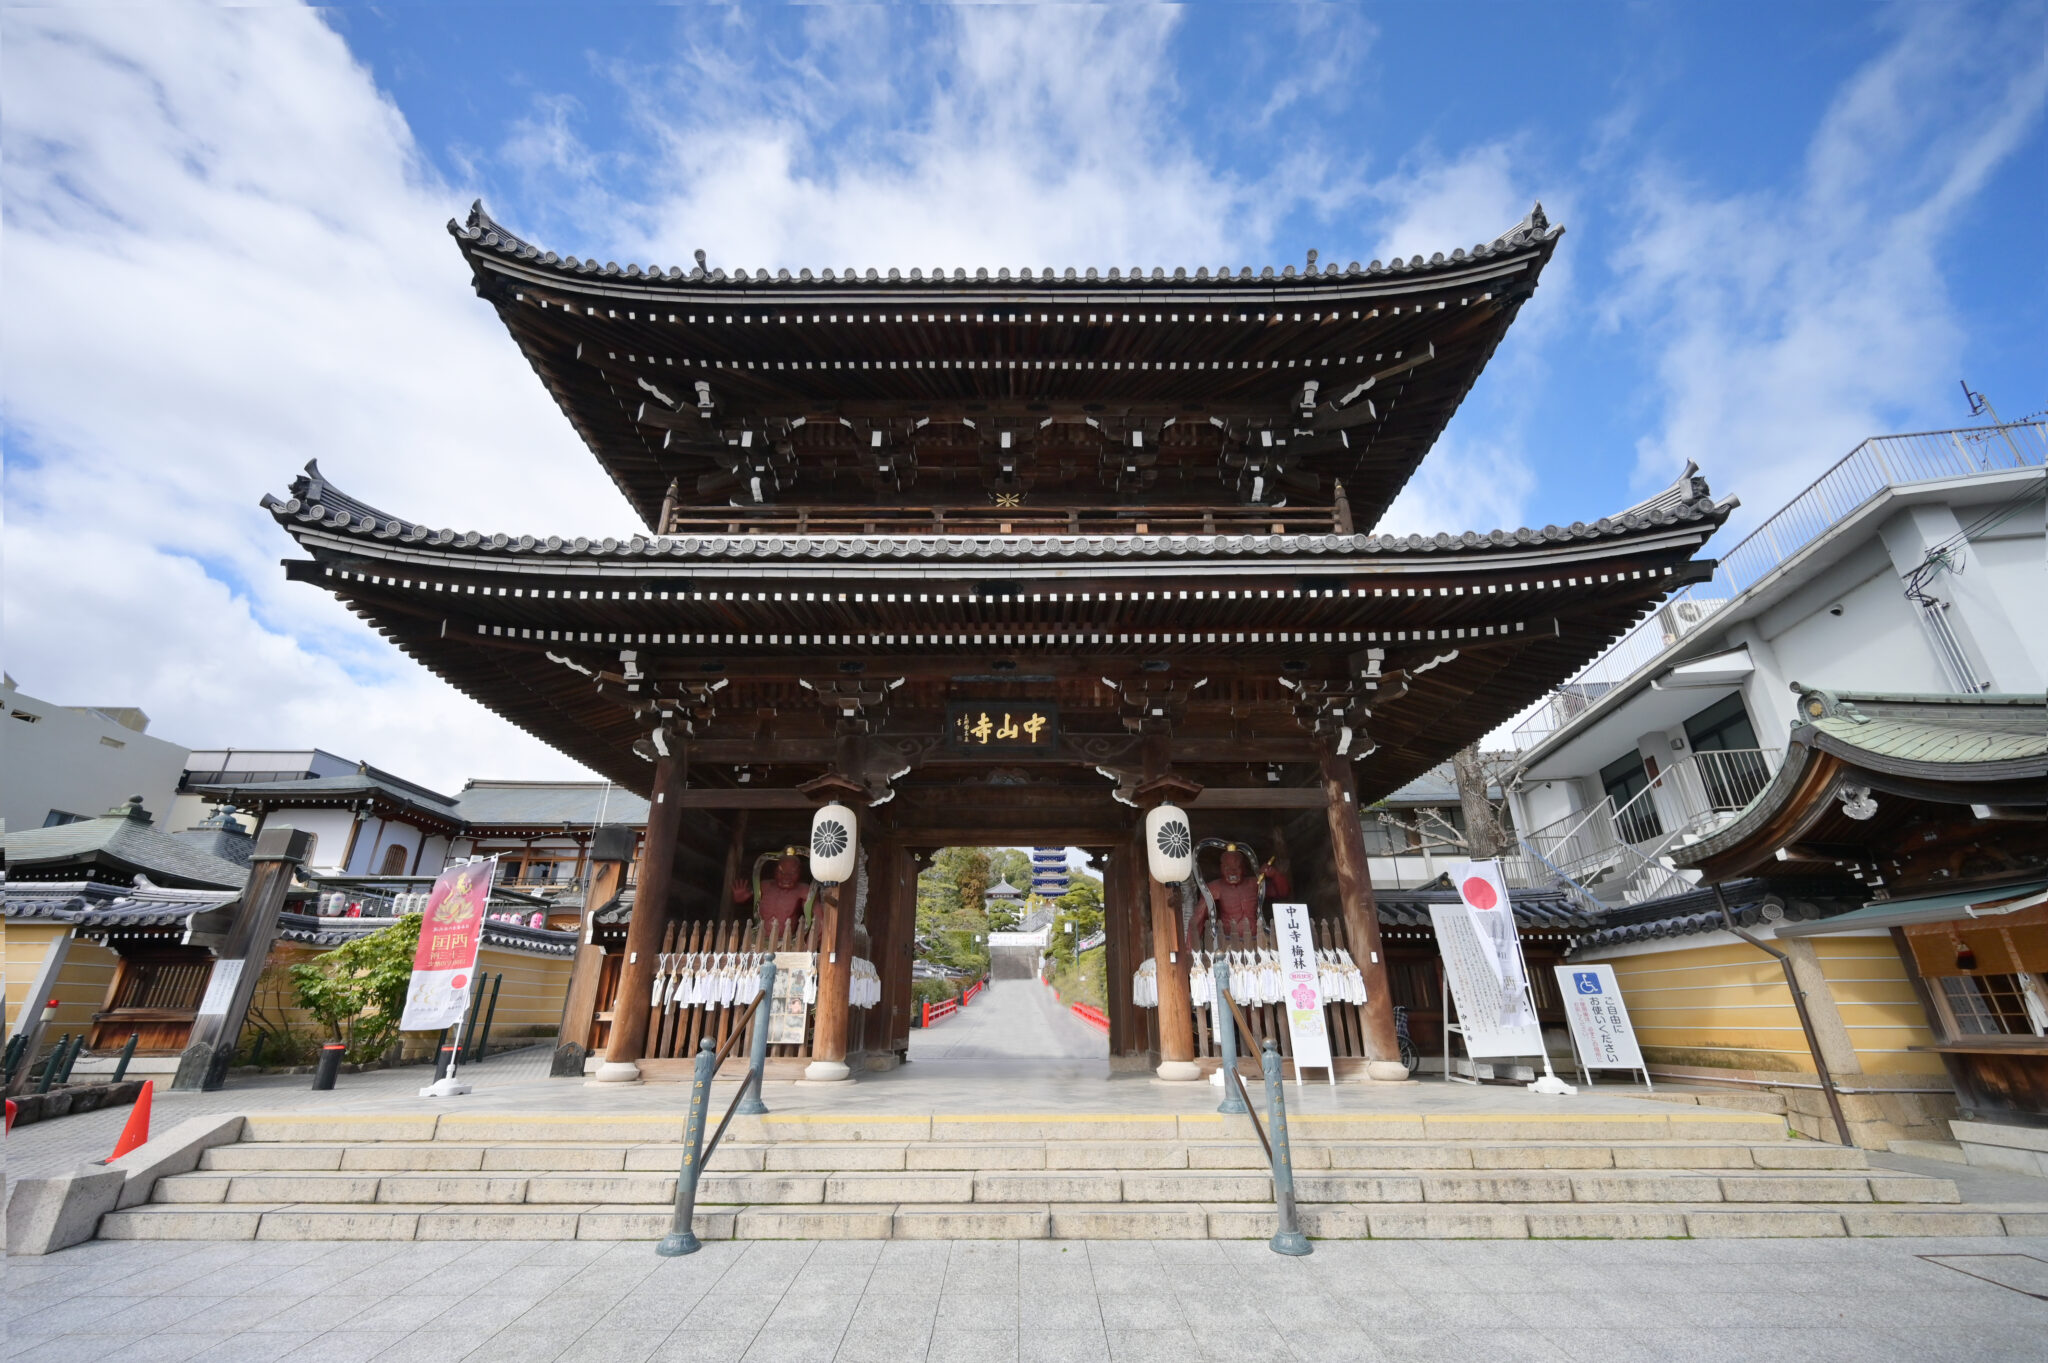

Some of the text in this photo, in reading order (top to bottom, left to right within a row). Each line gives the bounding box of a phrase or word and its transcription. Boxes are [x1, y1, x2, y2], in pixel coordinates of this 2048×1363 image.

[970, 712, 1047, 744] 中山寺
[1285, 905, 1307, 970] 中山寺梅林
[1589, 997, 1619, 1063] お使いください
[1604, 996, 1624, 1034] ご自由に
